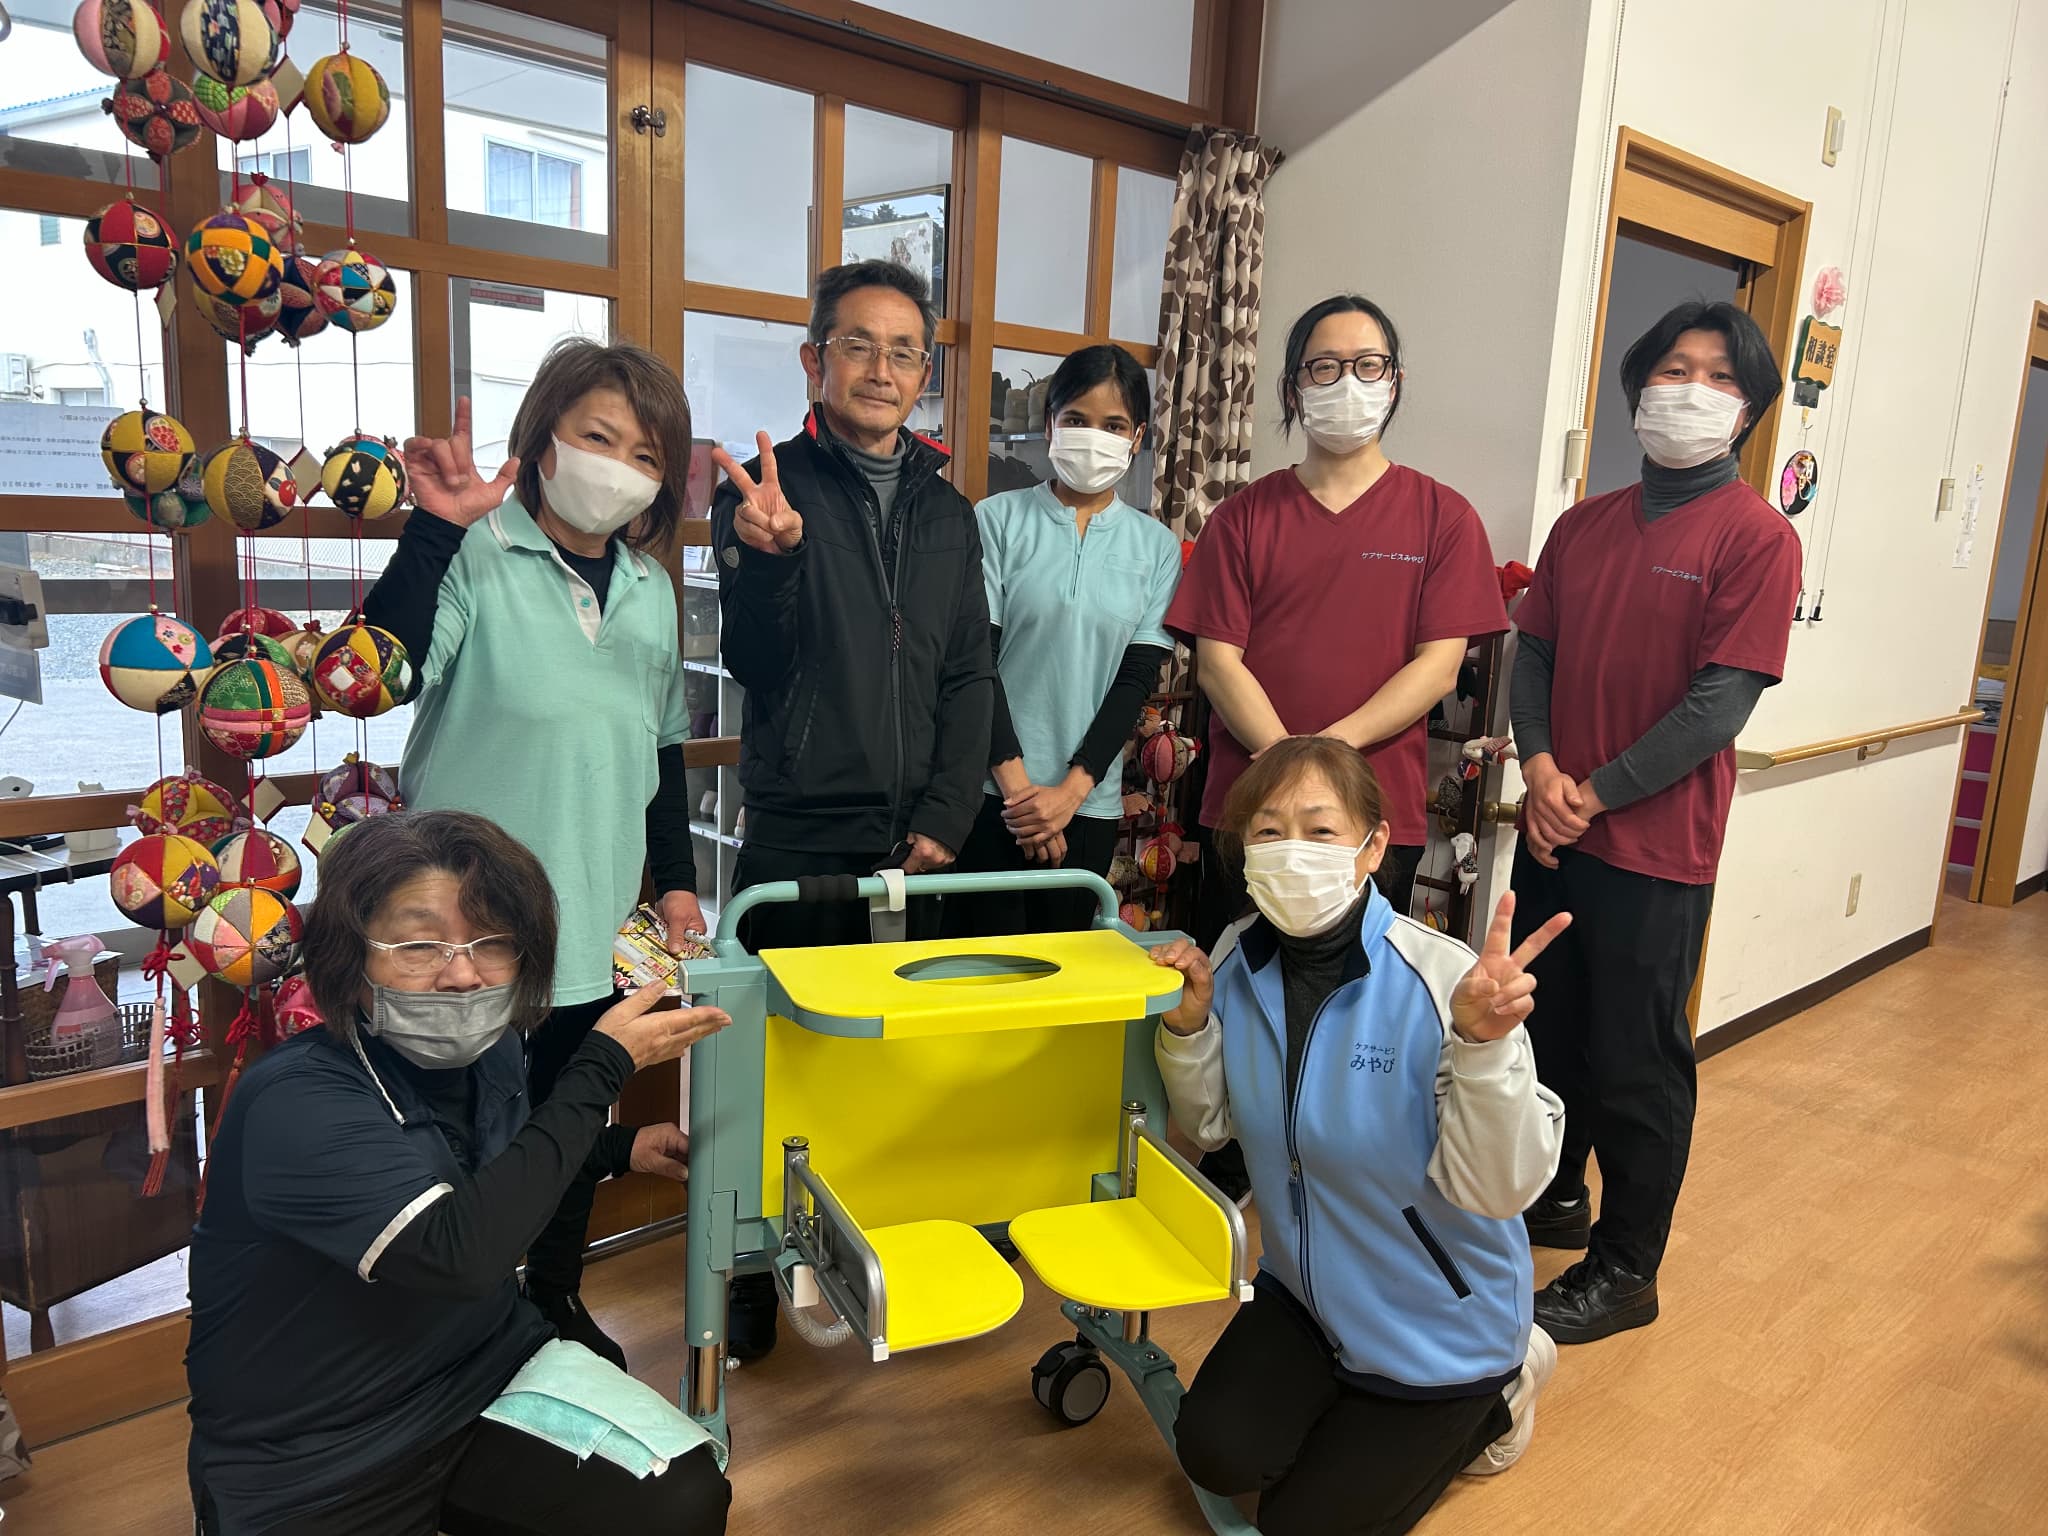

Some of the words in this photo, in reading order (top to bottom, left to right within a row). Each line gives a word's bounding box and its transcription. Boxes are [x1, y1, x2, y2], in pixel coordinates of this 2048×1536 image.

[1805, 336, 1837, 369] 相談室
[1361, 552, 1425, 564] ケアサービスみやび
[1354, 1042, 1395, 1055] ケアサービス
[1350, 1054, 1395, 1074] みやび
